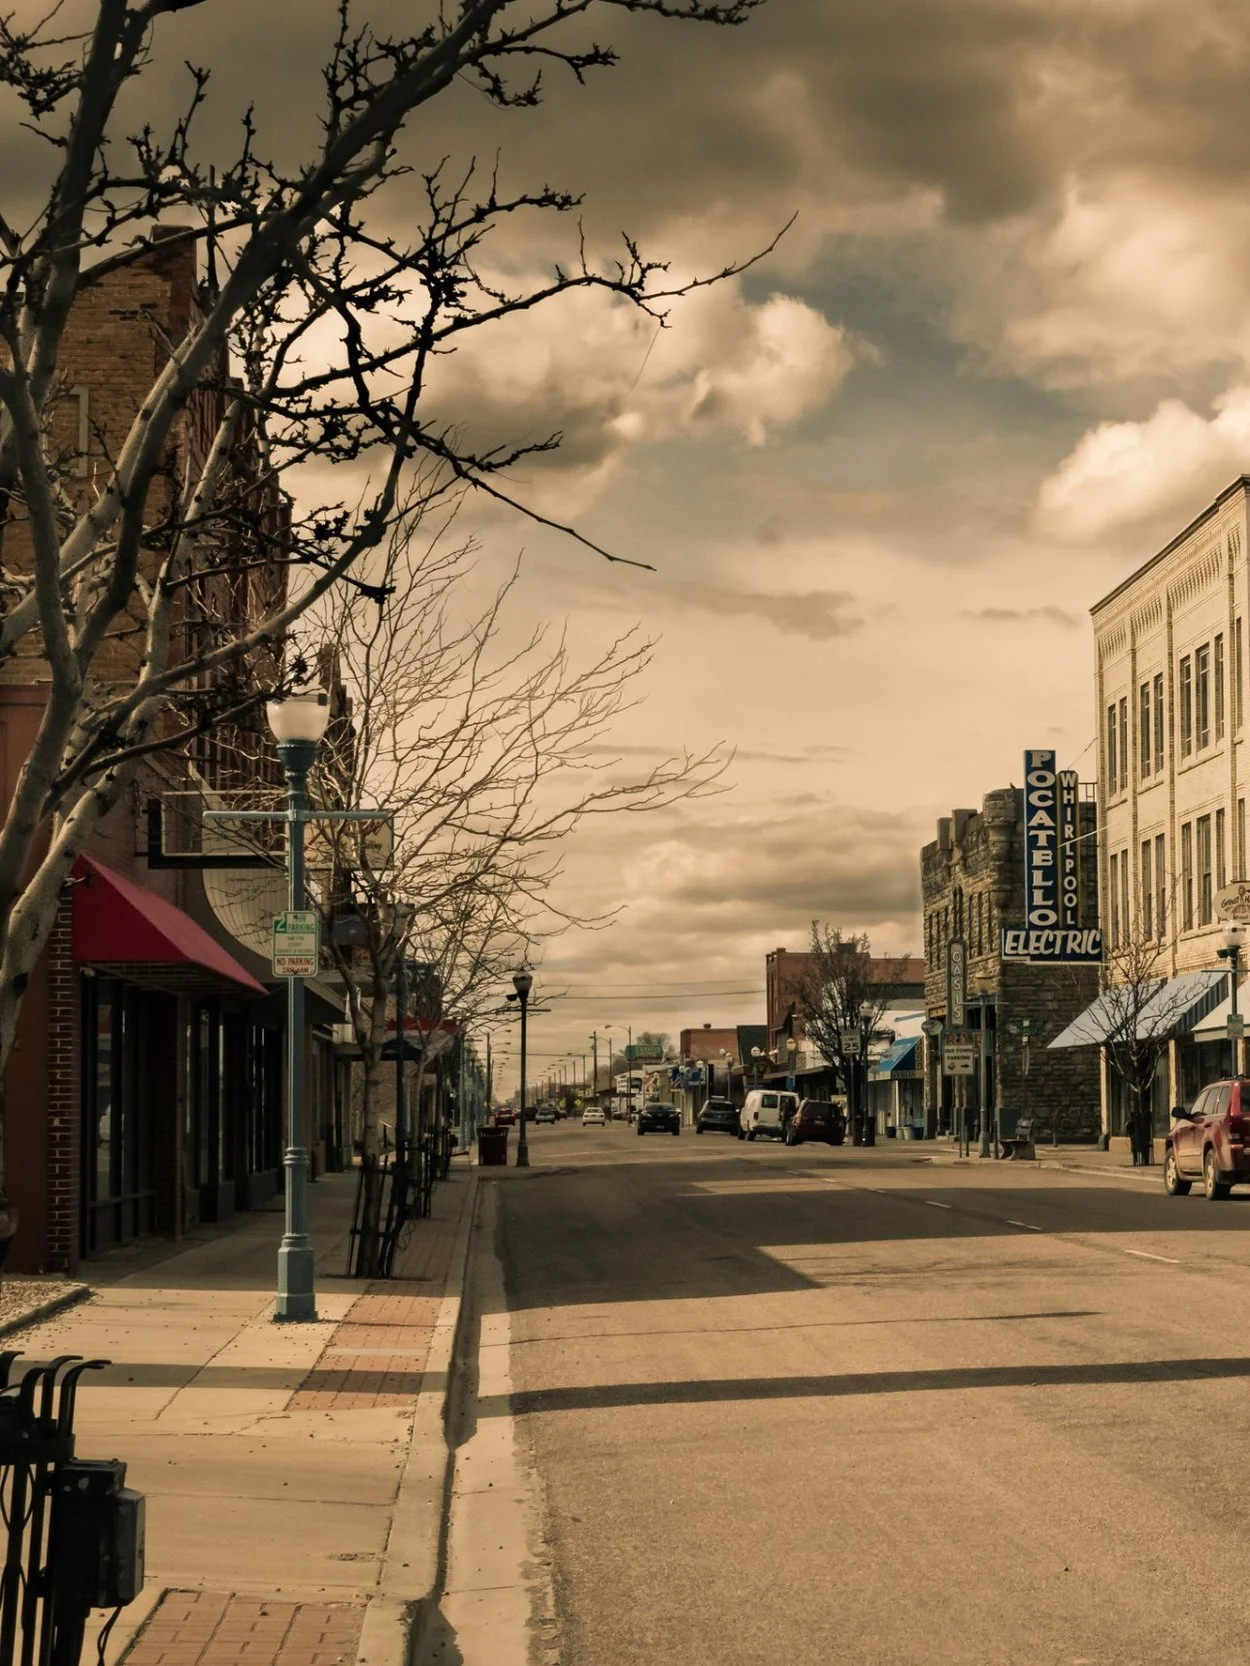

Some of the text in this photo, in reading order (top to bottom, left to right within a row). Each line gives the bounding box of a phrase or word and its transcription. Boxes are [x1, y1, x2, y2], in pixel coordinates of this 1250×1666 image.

[1027, 751, 1058, 927] POCATELLO
[1060, 772, 1078, 926] WHIRLPOOL
[277, 958, 314, 966] NO PARKING
[1004, 928, 1101, 956] ELECTRIC
[952, 950, 962, 1019] OASIS
[843, 1042, 860, 1052] 25
